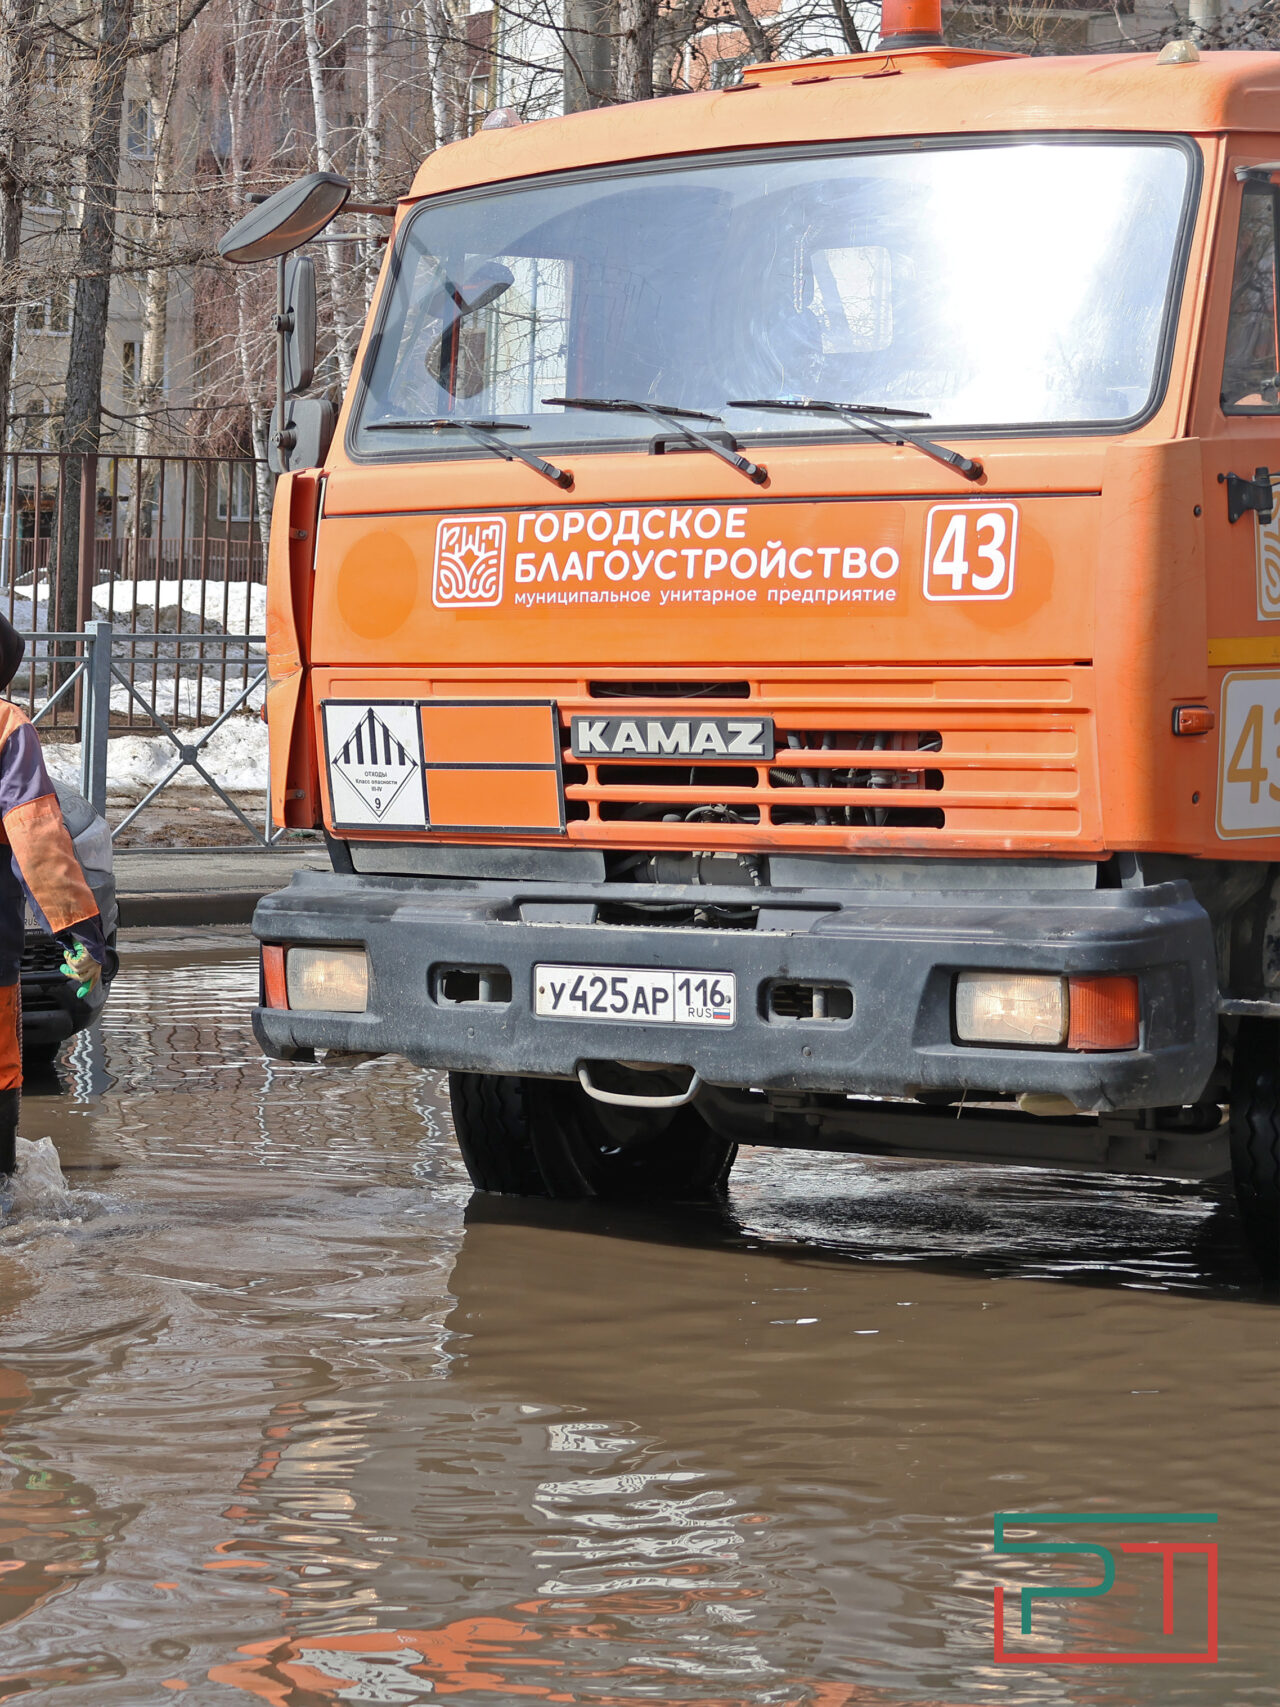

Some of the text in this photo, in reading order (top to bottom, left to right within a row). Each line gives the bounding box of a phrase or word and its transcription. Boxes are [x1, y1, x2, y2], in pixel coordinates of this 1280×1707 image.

[517, 507, 748, 546] ГОРОДСКОЕ
[514, 540, 900, 583] БЛАГОУСТРОЙСТВО
[932, 512, 1006, 591] 43
[514, 586, 896, 608] муниципальное унитарное предприятие
[578, 721, 764, 755] KAMAZ
[374, 797, 382, 809] 9
[550, 975, 725, 1015] У425АР 116
[688, 1007, 712, 1018] RUS
